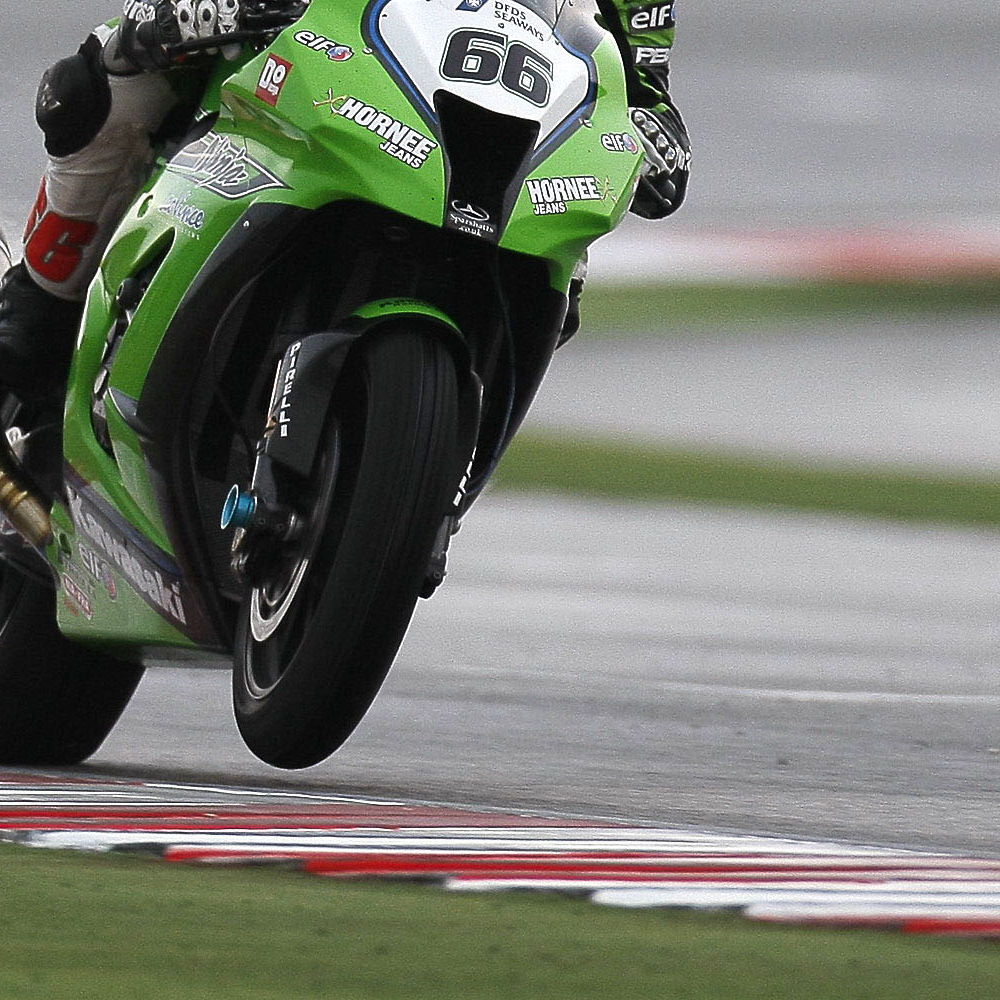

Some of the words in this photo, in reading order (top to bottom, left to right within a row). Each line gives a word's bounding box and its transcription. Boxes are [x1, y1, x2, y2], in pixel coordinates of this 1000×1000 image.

[494, 0, 526, 20] DFDS
[293, 30, 339, 52] elf
[494, 10, 545, 42] SEAWAYS
[439, 27, 554, 109] 66
[338, 96, 439, 161] HORNEE
[379, 140, 424, 169] JEANS
[526, 175, 605, 204] HORNEE
[533, 201, 567, 216] JEANS
[279, 341, 301, 437] PIRELLI
[65, 485, 186, 625] Kawasaki
